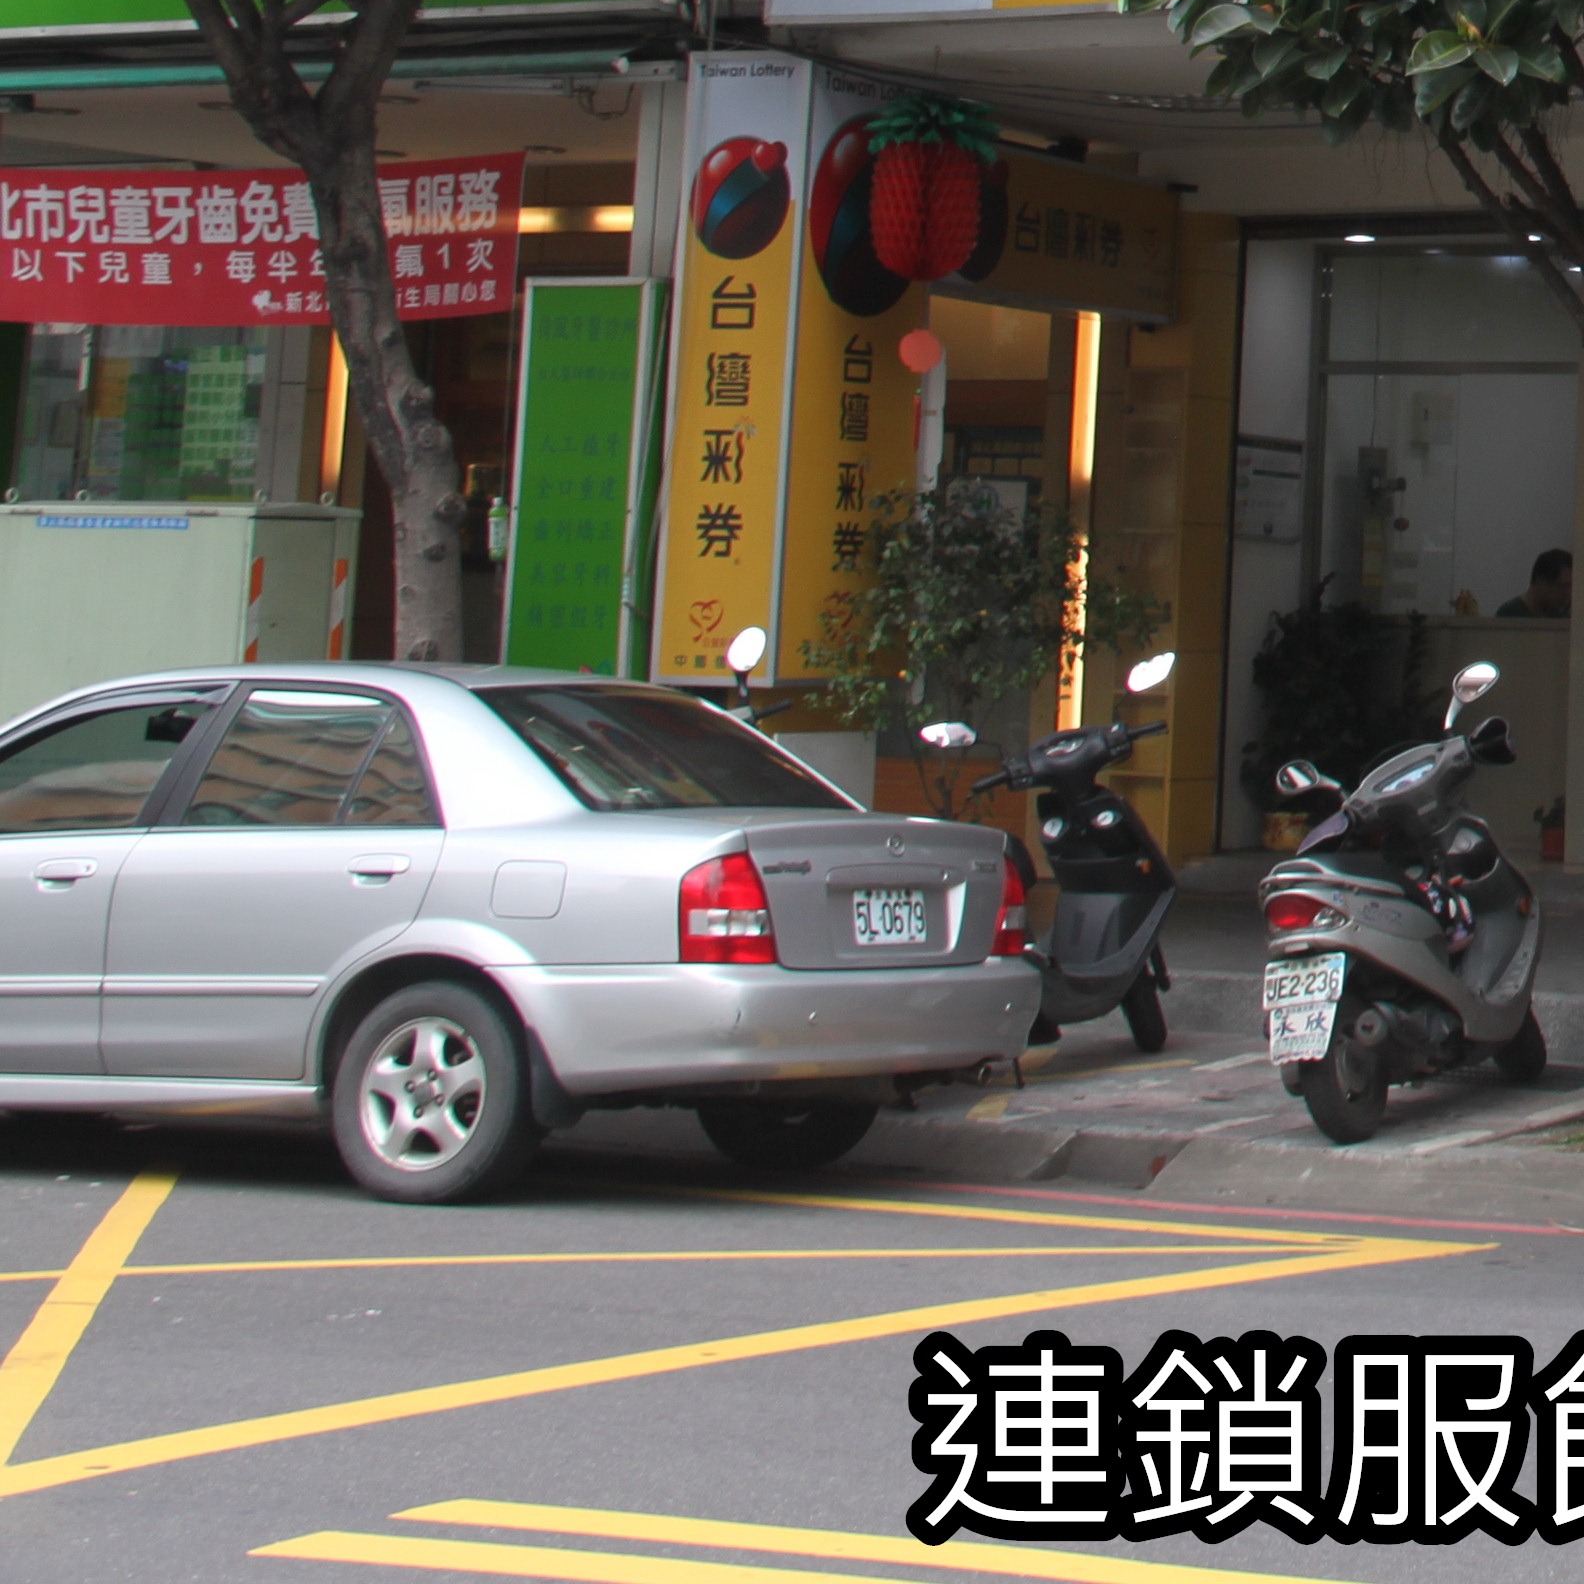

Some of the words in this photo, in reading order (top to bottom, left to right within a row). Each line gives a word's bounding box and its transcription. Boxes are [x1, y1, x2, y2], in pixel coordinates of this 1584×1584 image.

[699, 62, 746, 79] Taiwan
[750, 62, 796, 81] Lottery
[825, 69, 877, 98] Taiwan
[695, 274, 758, 562] 台灣彩券
[832, 334, 873, 573] 台灣彩券
